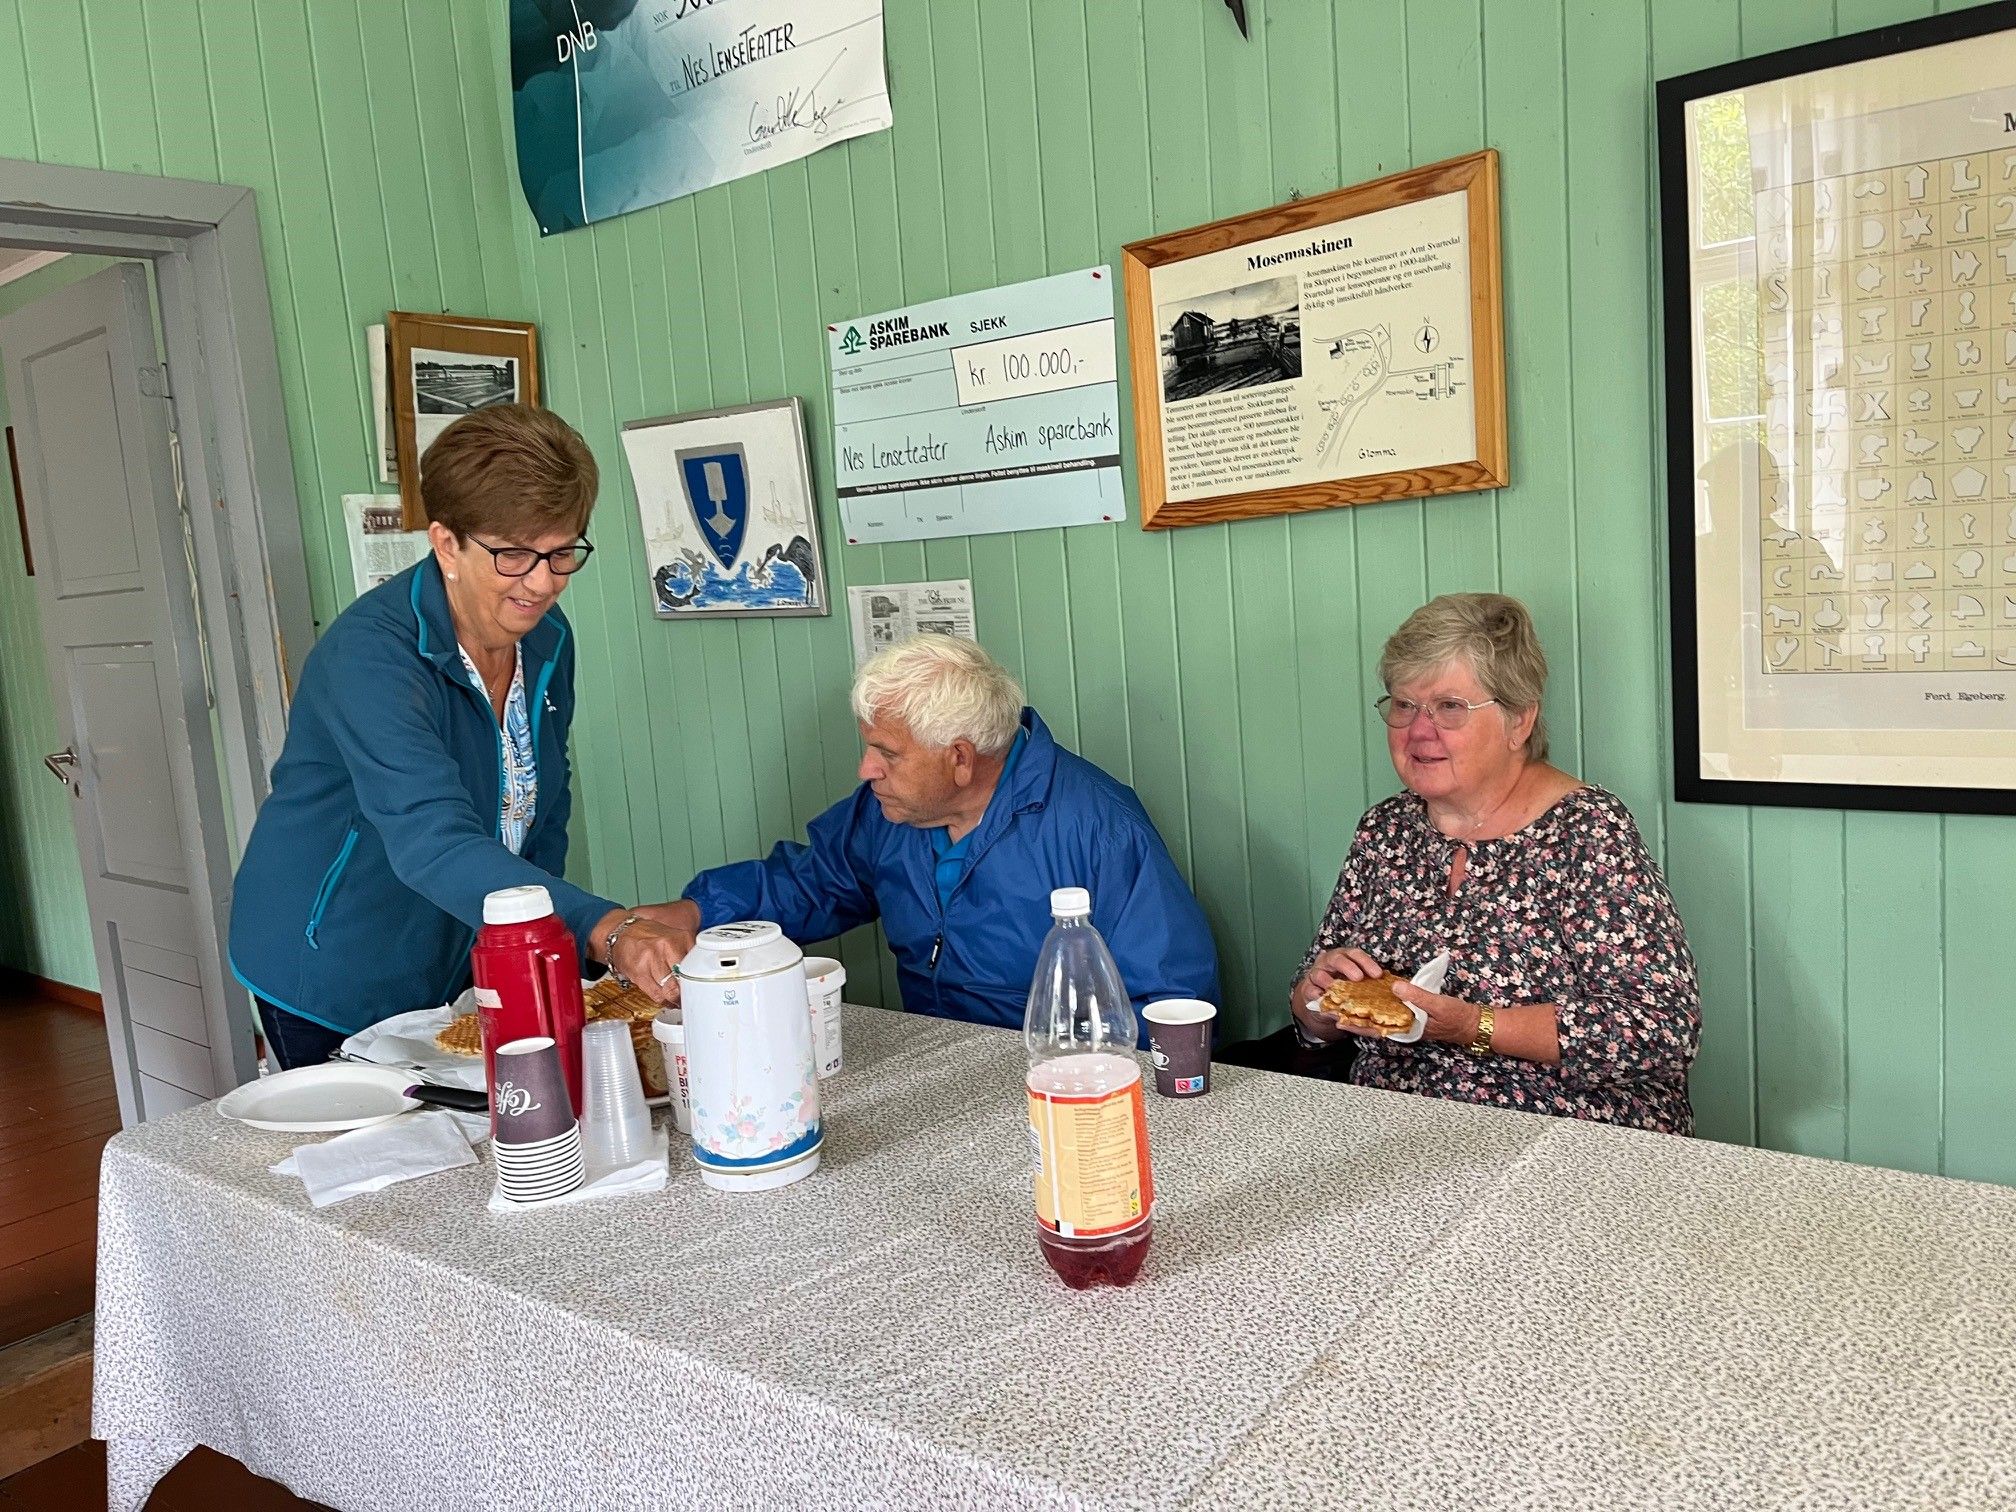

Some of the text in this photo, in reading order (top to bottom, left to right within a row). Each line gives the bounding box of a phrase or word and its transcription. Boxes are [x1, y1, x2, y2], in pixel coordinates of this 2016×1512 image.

[556, 20, 598, 63] DNB
[681, 53, 709, 91] NES
[1247, 237, 1353, 272] Mosemaskinen
[869, 315, 909, 337] ASKIM
[869, 322, 950, 350] SPAREBANK
[970, 315, 1007, 333] SJEKK
[1003, 348, 1084, 383] 100.000,-
[985, 411, 1113, 455] Askim sparebank
[843, 432, 949, 472] Nes Lenseteater
